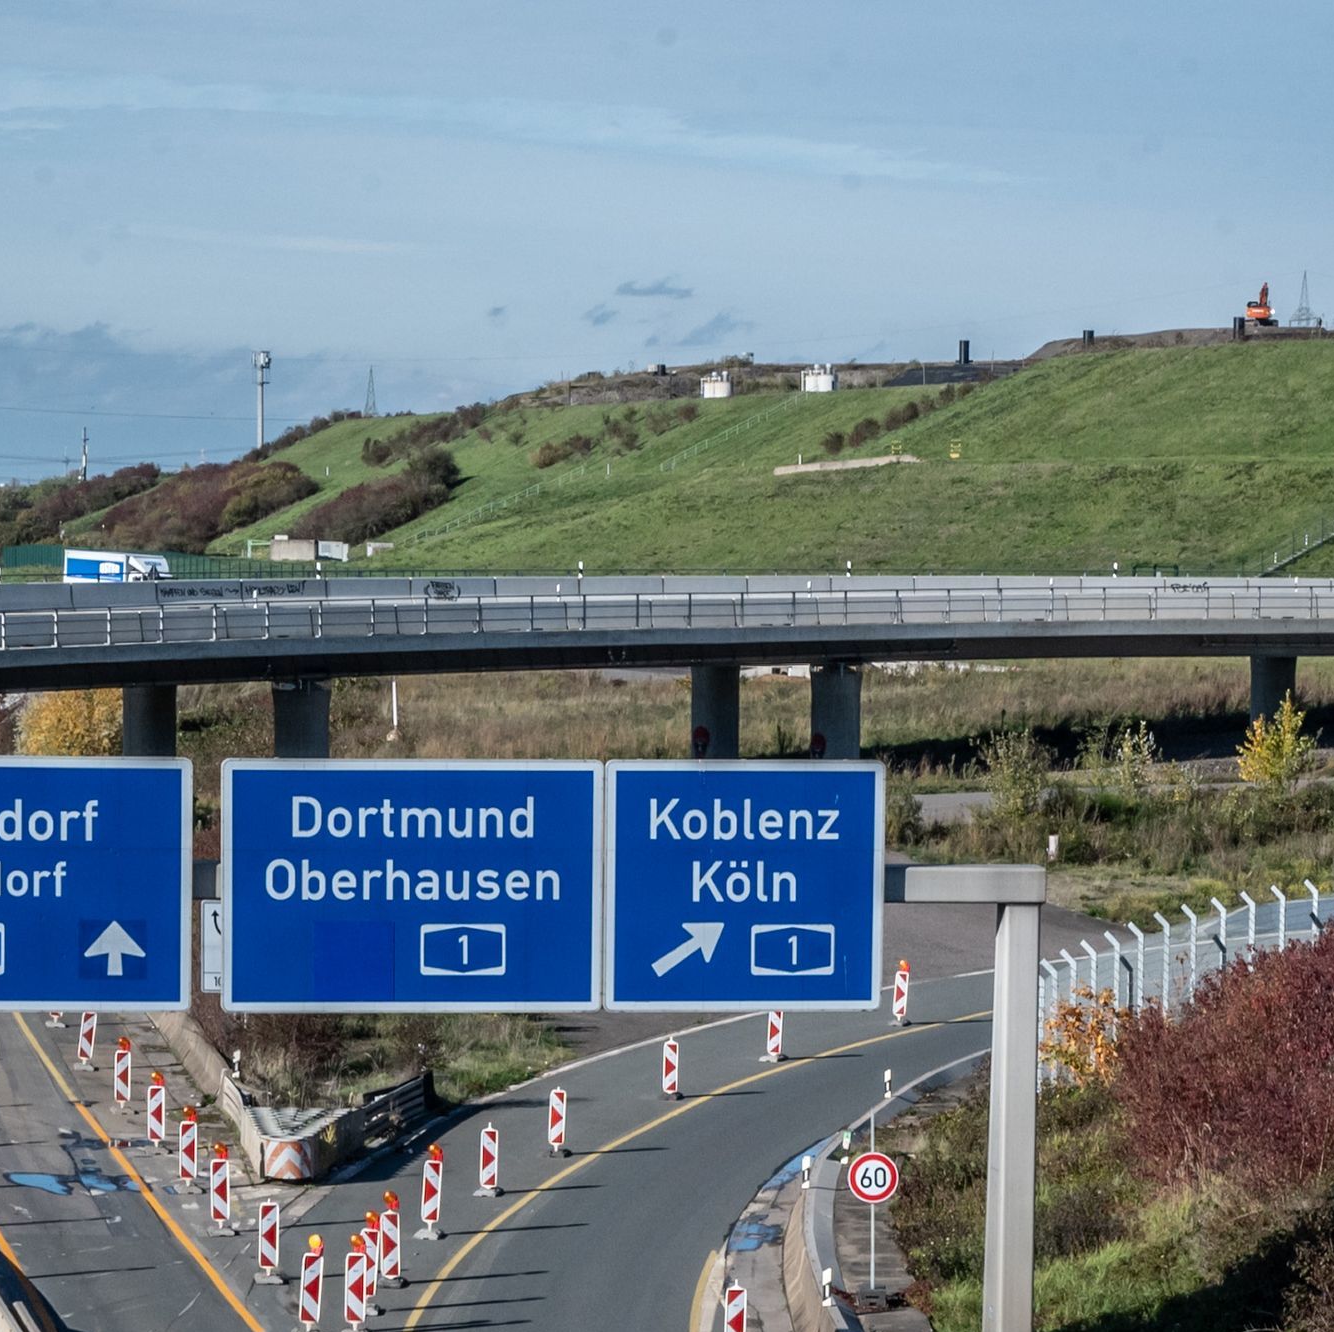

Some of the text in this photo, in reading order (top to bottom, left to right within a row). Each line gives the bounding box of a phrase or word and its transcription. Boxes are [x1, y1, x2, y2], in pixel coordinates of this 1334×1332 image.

[292, 796, 534, 839] Dortmund
[649, 798, 840, 841] Koblenz
[265, 858, 560, 901] Oberhausen
[692, 860, 797, 903] Köln
[457, 934, 468, 965] 1
[788, 935, 799, 965] 1
[860, 1167, 887, 1188] 60
